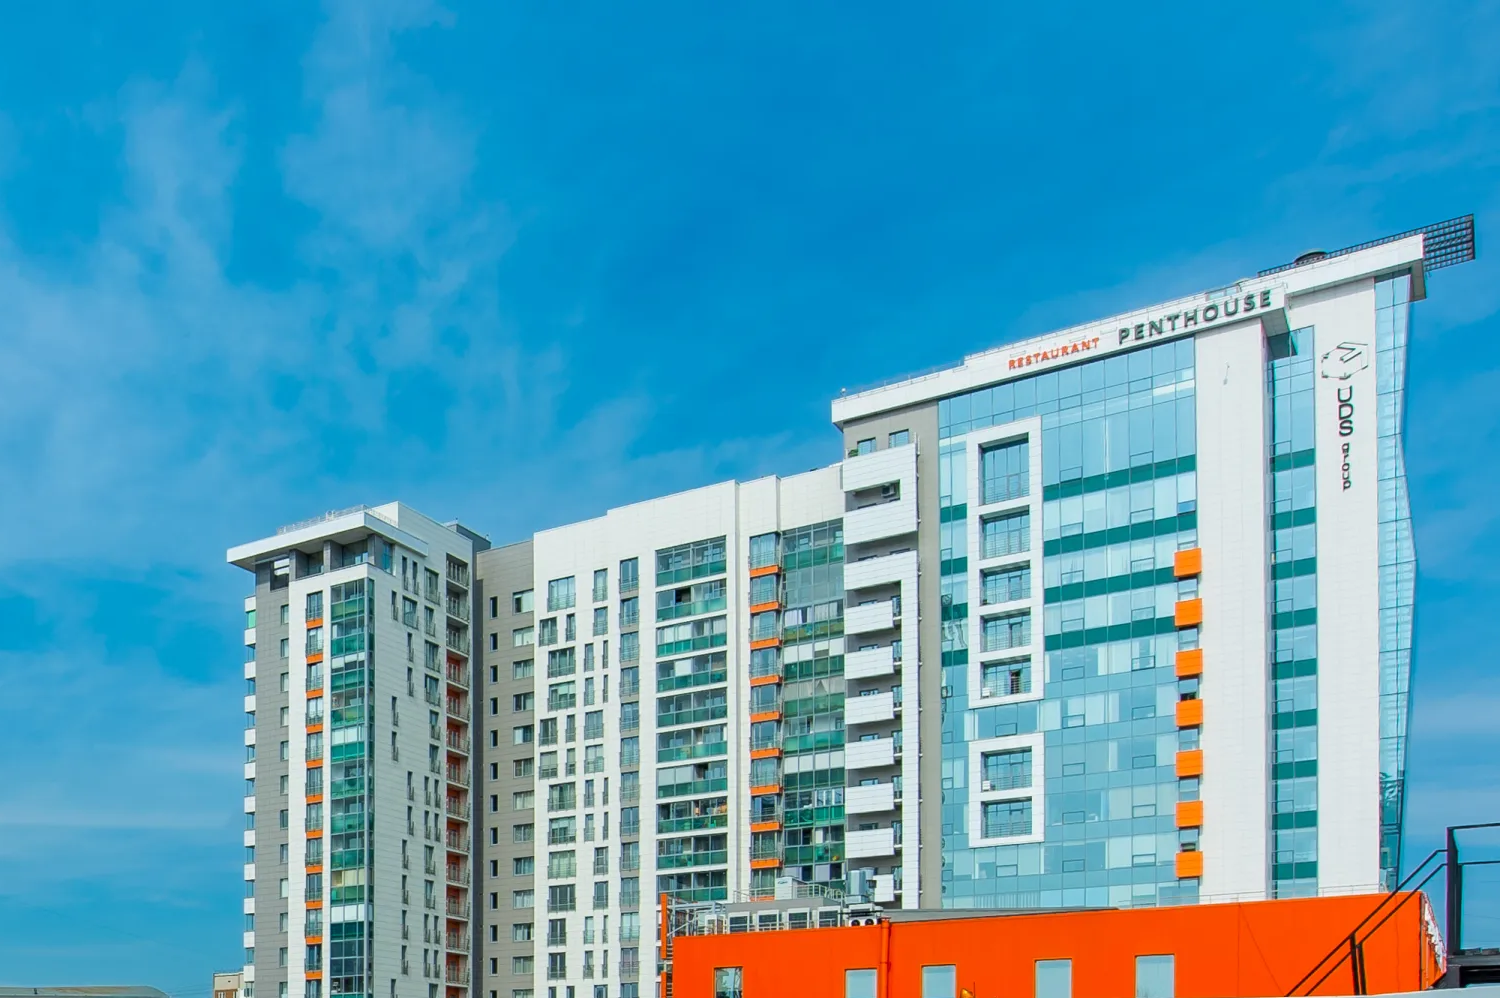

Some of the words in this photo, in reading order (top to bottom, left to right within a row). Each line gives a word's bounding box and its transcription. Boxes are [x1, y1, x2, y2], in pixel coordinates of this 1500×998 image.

[1008, 337, 1100, 370] RESTAURANT
[1118, 289, 1271, 344] PENTHOUSE
[1337, 385, 1354, 437] UDS
[1341, 442, 1352, 492] group
